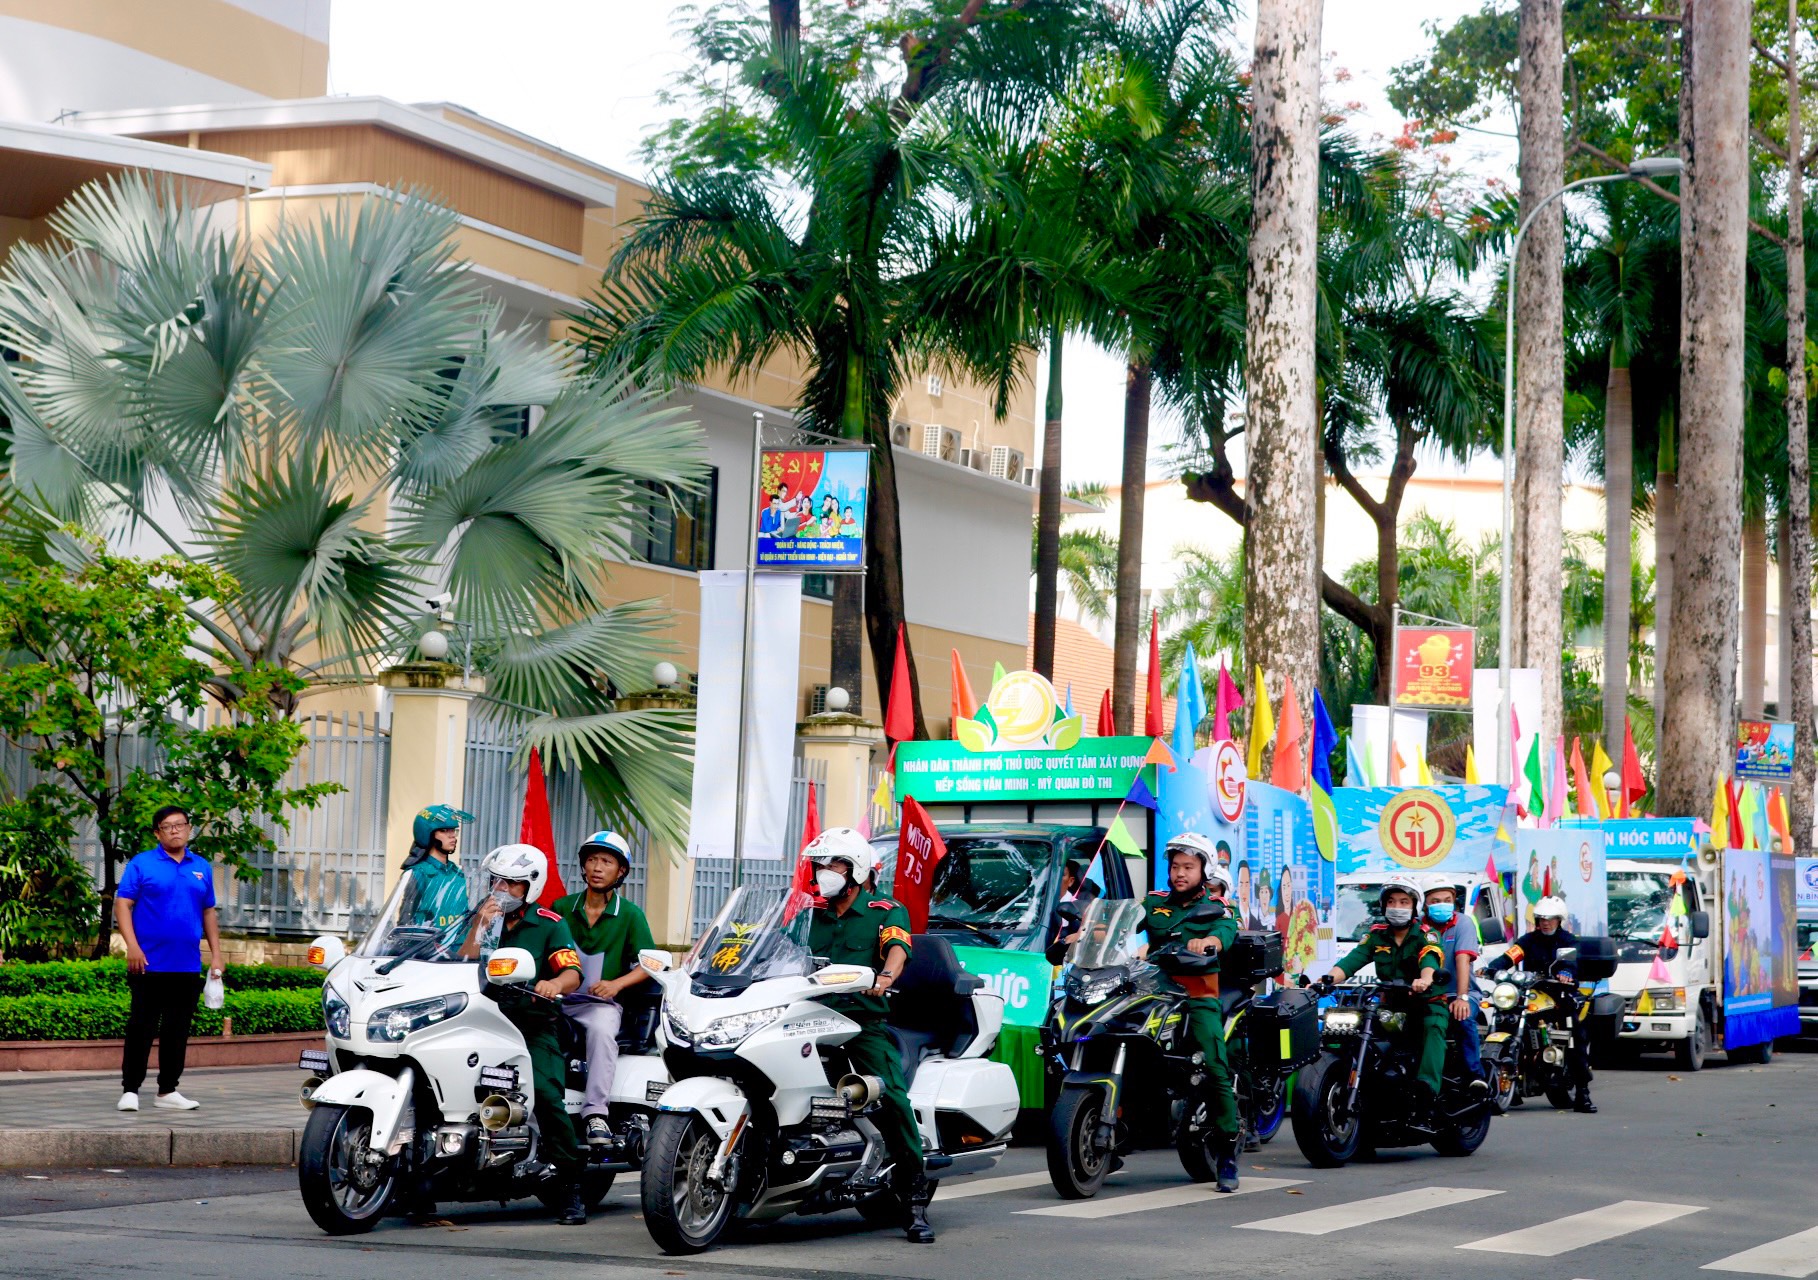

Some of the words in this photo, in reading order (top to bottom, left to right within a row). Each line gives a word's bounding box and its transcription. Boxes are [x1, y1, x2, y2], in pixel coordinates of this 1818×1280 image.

[1421, 665, 1448, 677] 93
[903, 758, 929, 772] NHÂN
[930, 757, 950, 772] DÂN
[952, 757, 982, 772] THÀNH
[983, 754, 1003, 771] PHỐ
[1005, 754, 1022, 771] THỦ
[1024, 755, 1043, 770] ĐỨC
[1045, 754, 1074, 770] QUYẾT
[1077, 754, 1097, 769] TÂM
[1099, 754, 1118, 769] XÂY
[935, 776, 954, 792] NẾP
[956, 775, 981, 792] SỐNG
[983, 776, 1002, 791] VĂN
[1004, 778, 1029, 790] MINH
[1038, 776, 1053, 790] MỸ
[1055, 777, 1080, 790] QUAN
[1082, 775, 1095, 789] ĐÔ
[1098, 777, 1112, 791] THỊ
[1619, 828, 1649, 846] HÓC
[1653, 828, 1687, 845] MÔN
[1806, 892, 1818, 900] BÌN
[1346, 975, 1378, 984] ZUK
